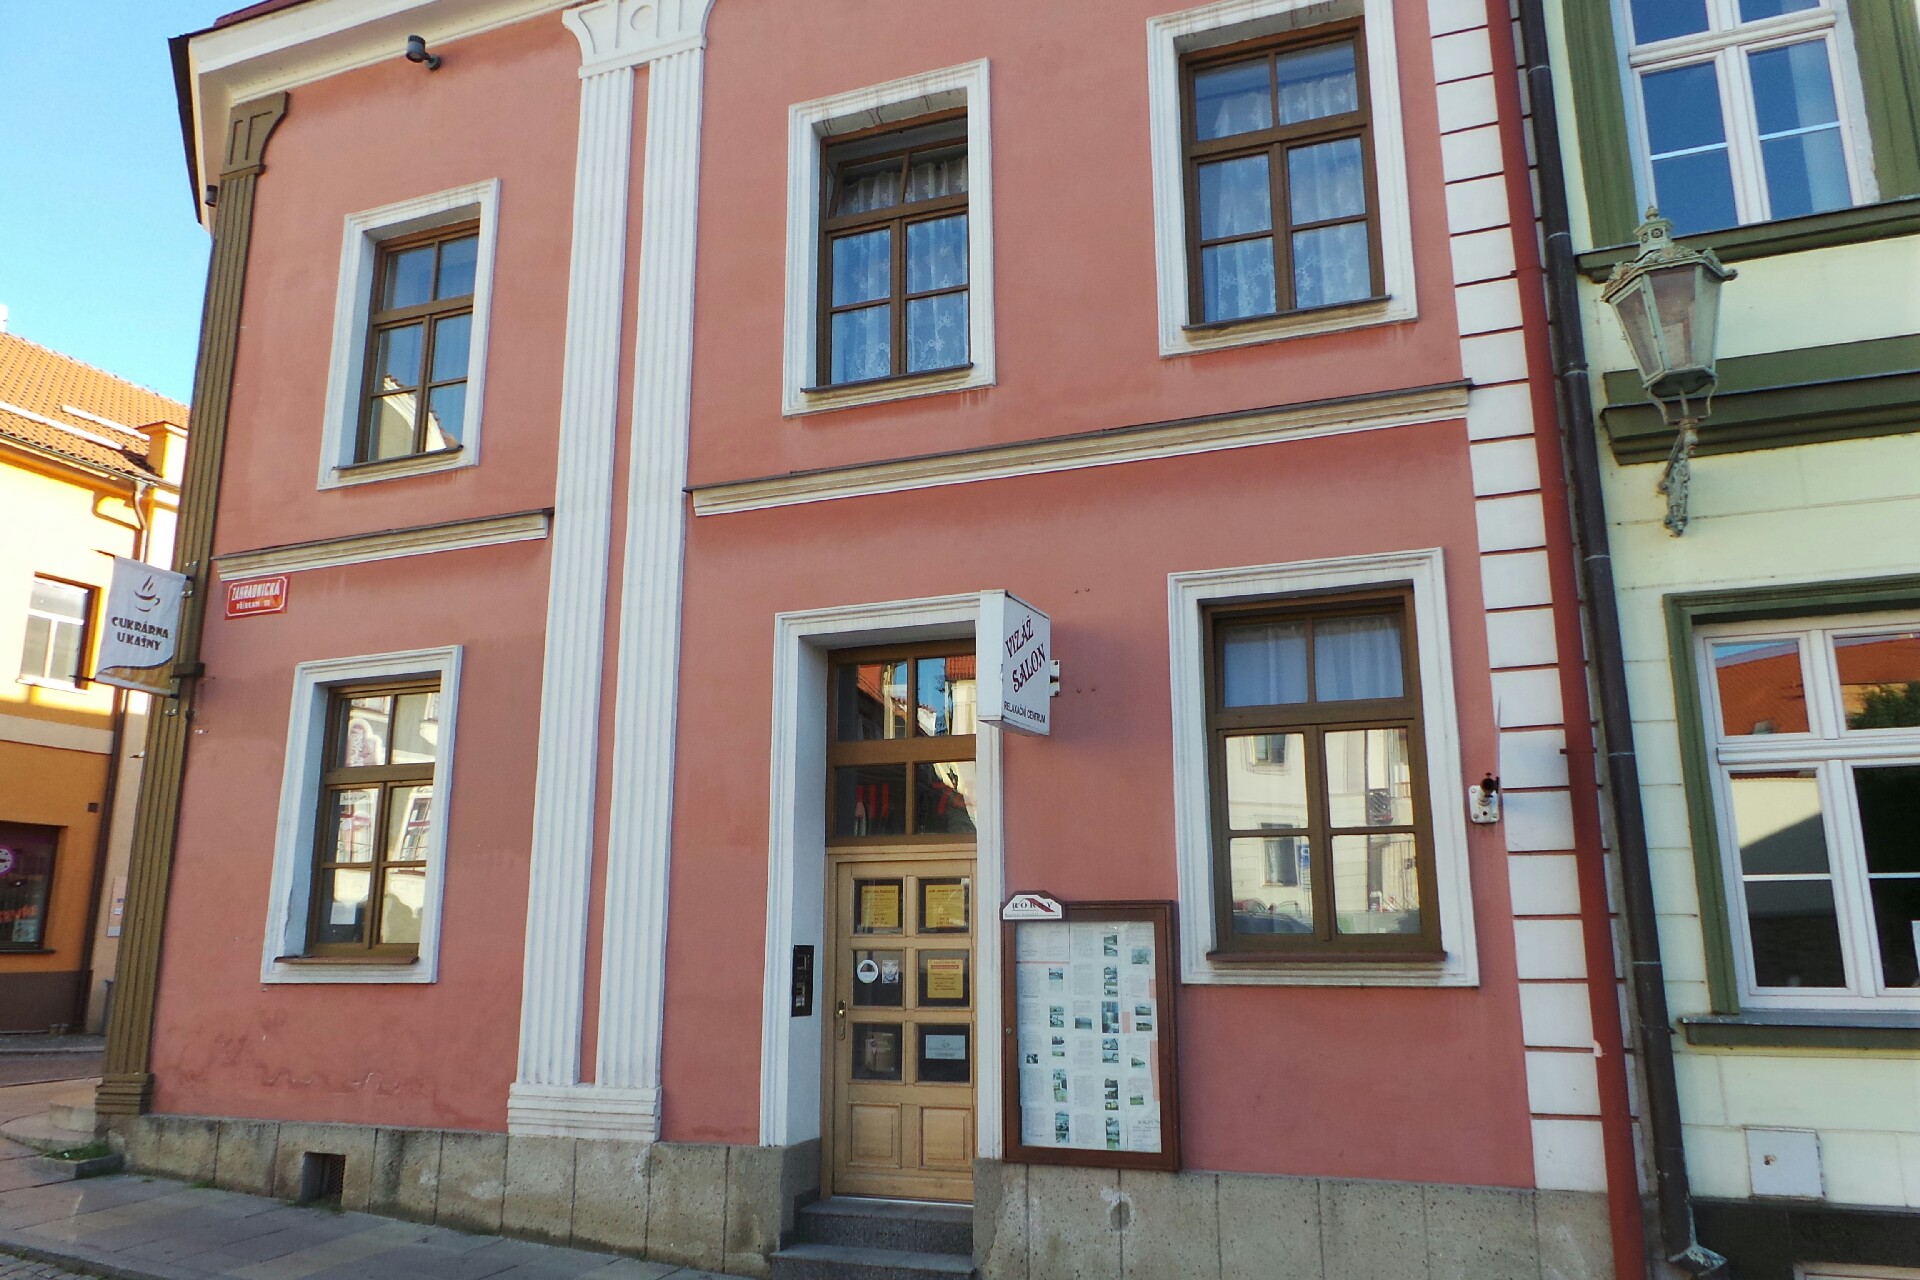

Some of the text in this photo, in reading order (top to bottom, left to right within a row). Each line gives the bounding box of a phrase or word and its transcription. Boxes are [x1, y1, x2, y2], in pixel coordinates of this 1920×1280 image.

[231, 580, 280, 601] ZAHRADNICKÁ
[111, 616, 169, 639] CUKRÁRNA
[1004, 615, 1034, 659] VIZÁŽ
[1012, 643, 1046, 693] SALON
[1027, 709, 1046, 723] CENTRUM
